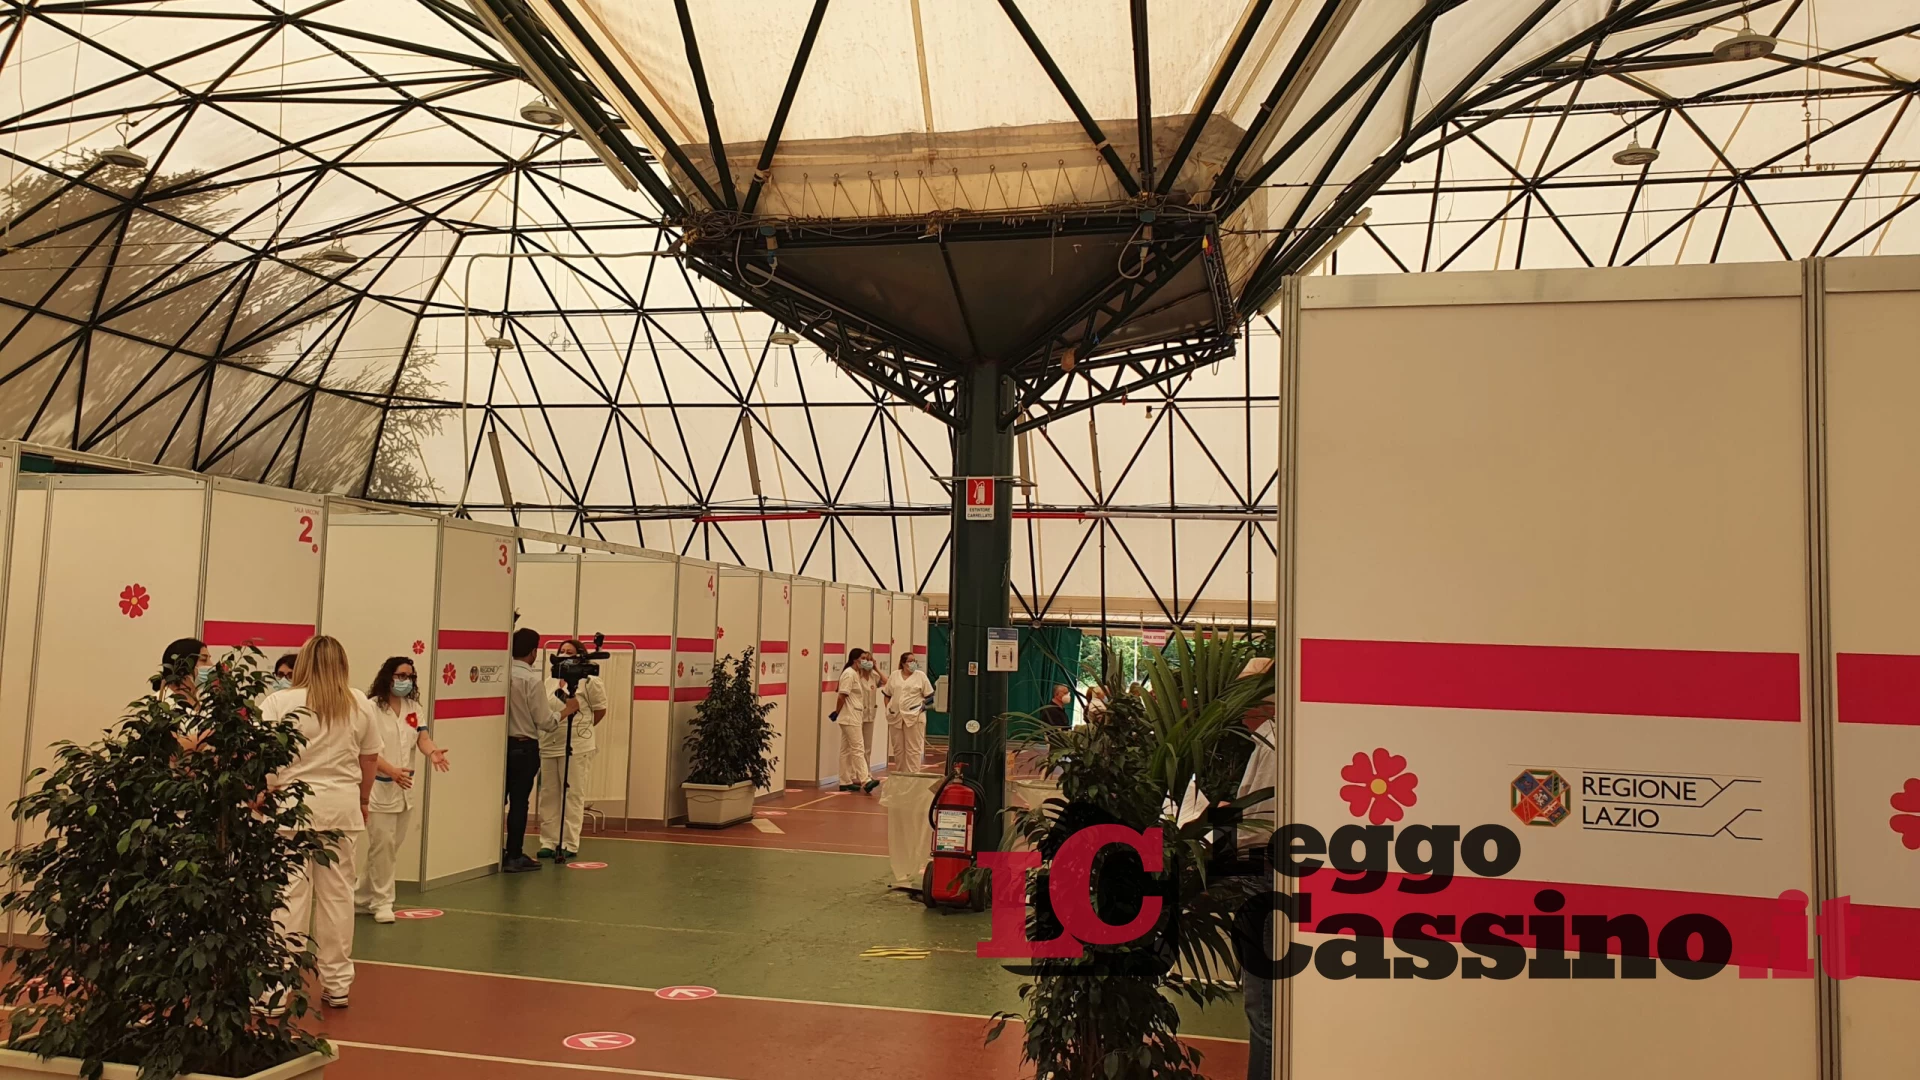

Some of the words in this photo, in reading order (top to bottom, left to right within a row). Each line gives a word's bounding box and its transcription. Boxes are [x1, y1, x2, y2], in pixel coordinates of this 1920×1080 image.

[299, 516, 313, 543] 2
[499, 545, 507, 566] 3
[708, 575, 714, 591] 4
[783, 586, 788, 600] 5
[1582, 776, 1697, 801] REGIONE
[1582, 805, 1660, 828] LAZIO
